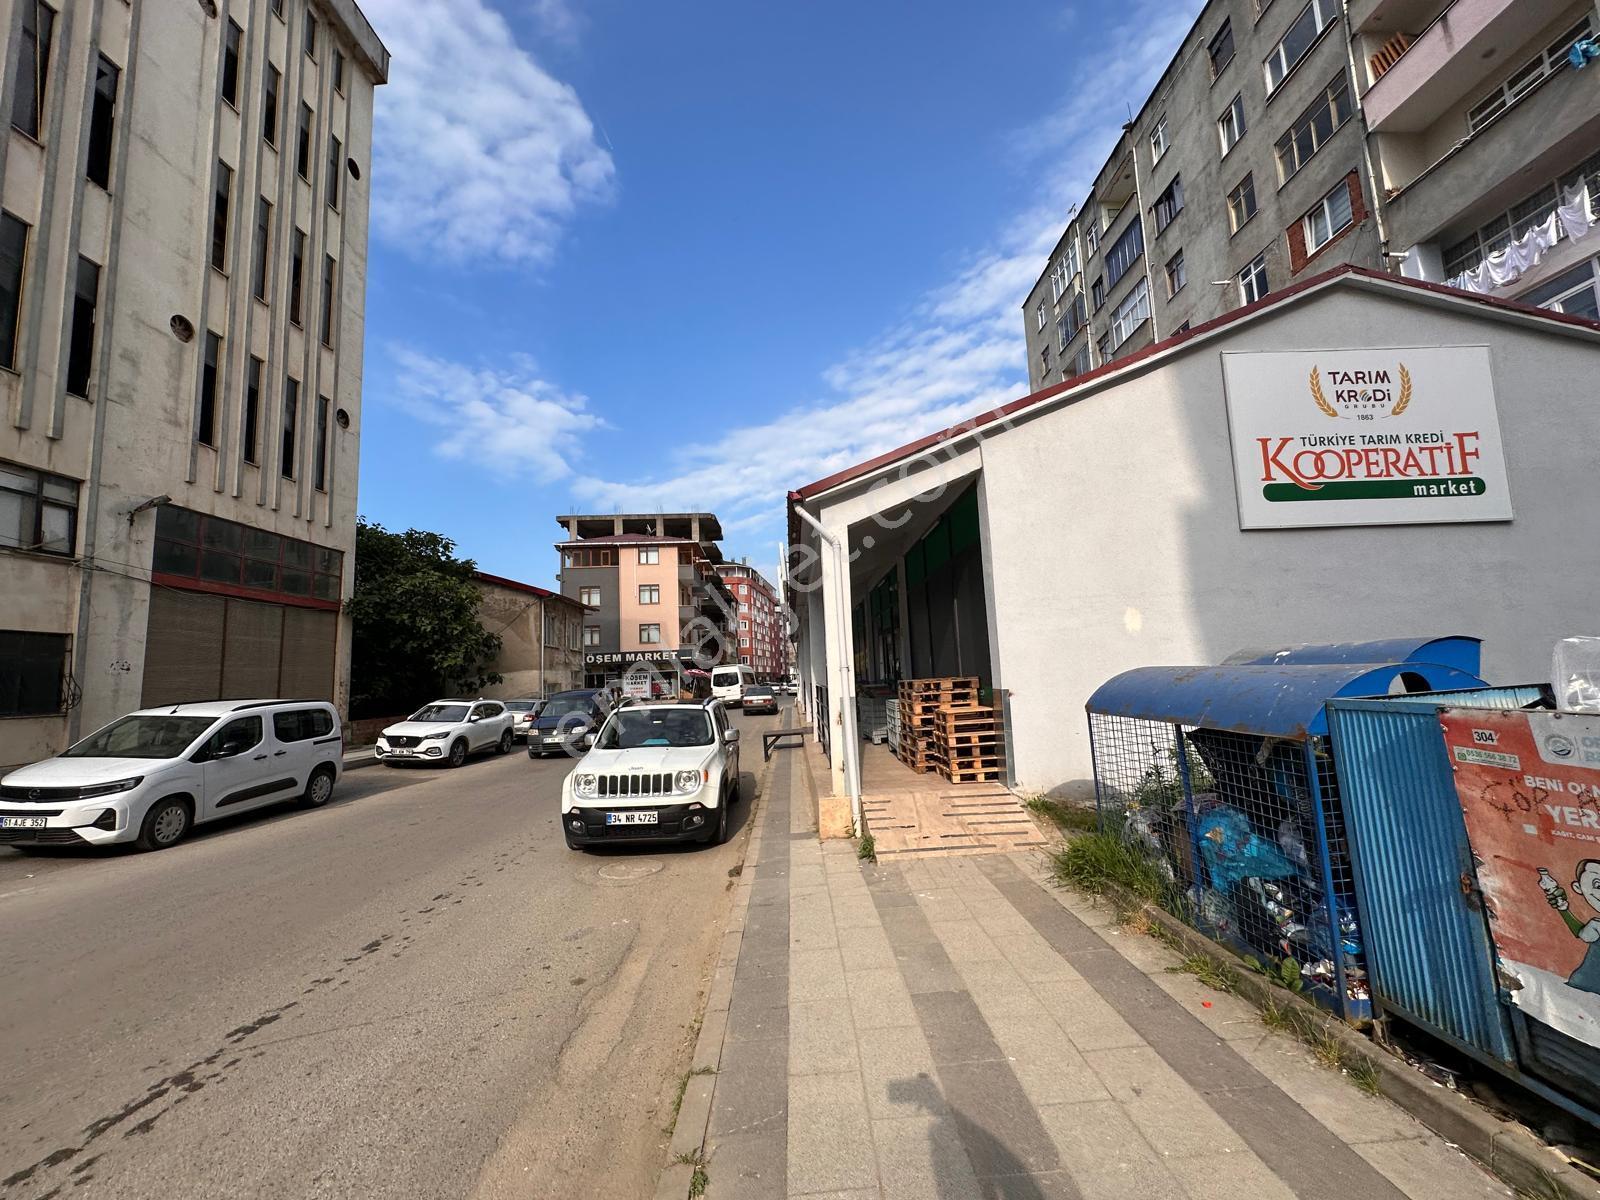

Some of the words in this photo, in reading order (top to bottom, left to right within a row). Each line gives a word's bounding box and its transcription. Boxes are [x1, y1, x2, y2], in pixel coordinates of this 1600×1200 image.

[1328, 370, 1391, 385] TARIM
[1300, 433, 1355, 447] TÜRKİYE
[1360, 434, 1401, 446] TARIM
[1405, 430, 1444, 444] KREDİ
[1256, 431, 1480, 491] KOOPERATİF
[1413, 479, 1477, 497] market
[584, 653, 622, 664] ÖŞEM
[625, 651, 678, 662] MARKET
[1474, 730, 1495, 743] 304
[4, 818, 12, 826] 61
[30, 818, 44, 826] 352
[612, 813, 622, 823] 34
[625, 813, 635, 823] NR
[638, 812, 656, 823] 4725
